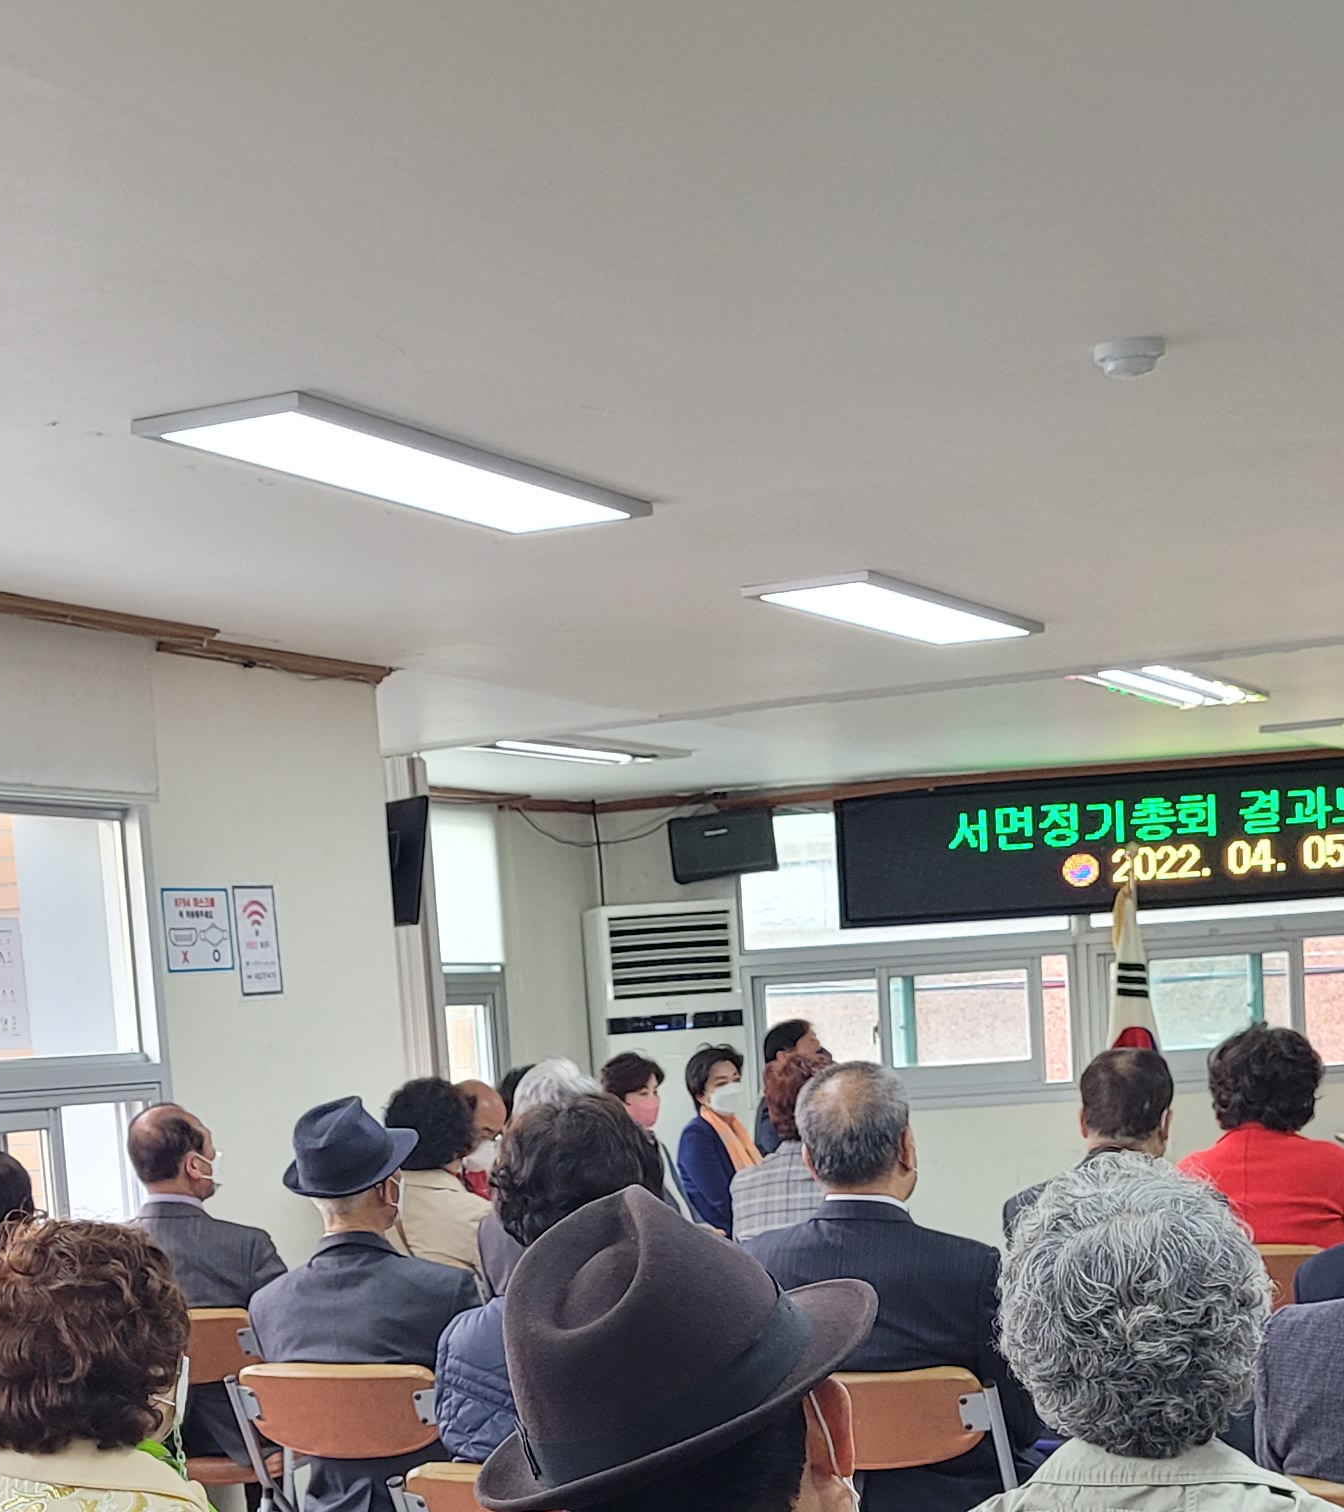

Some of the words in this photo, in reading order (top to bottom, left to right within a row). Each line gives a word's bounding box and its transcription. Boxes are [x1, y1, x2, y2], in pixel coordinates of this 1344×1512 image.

[949, 794, 1217, 853] 서면정기총회
[1111, 843, 1212, 883] 2022.
[1227, 838, 1287, 876] 04.
